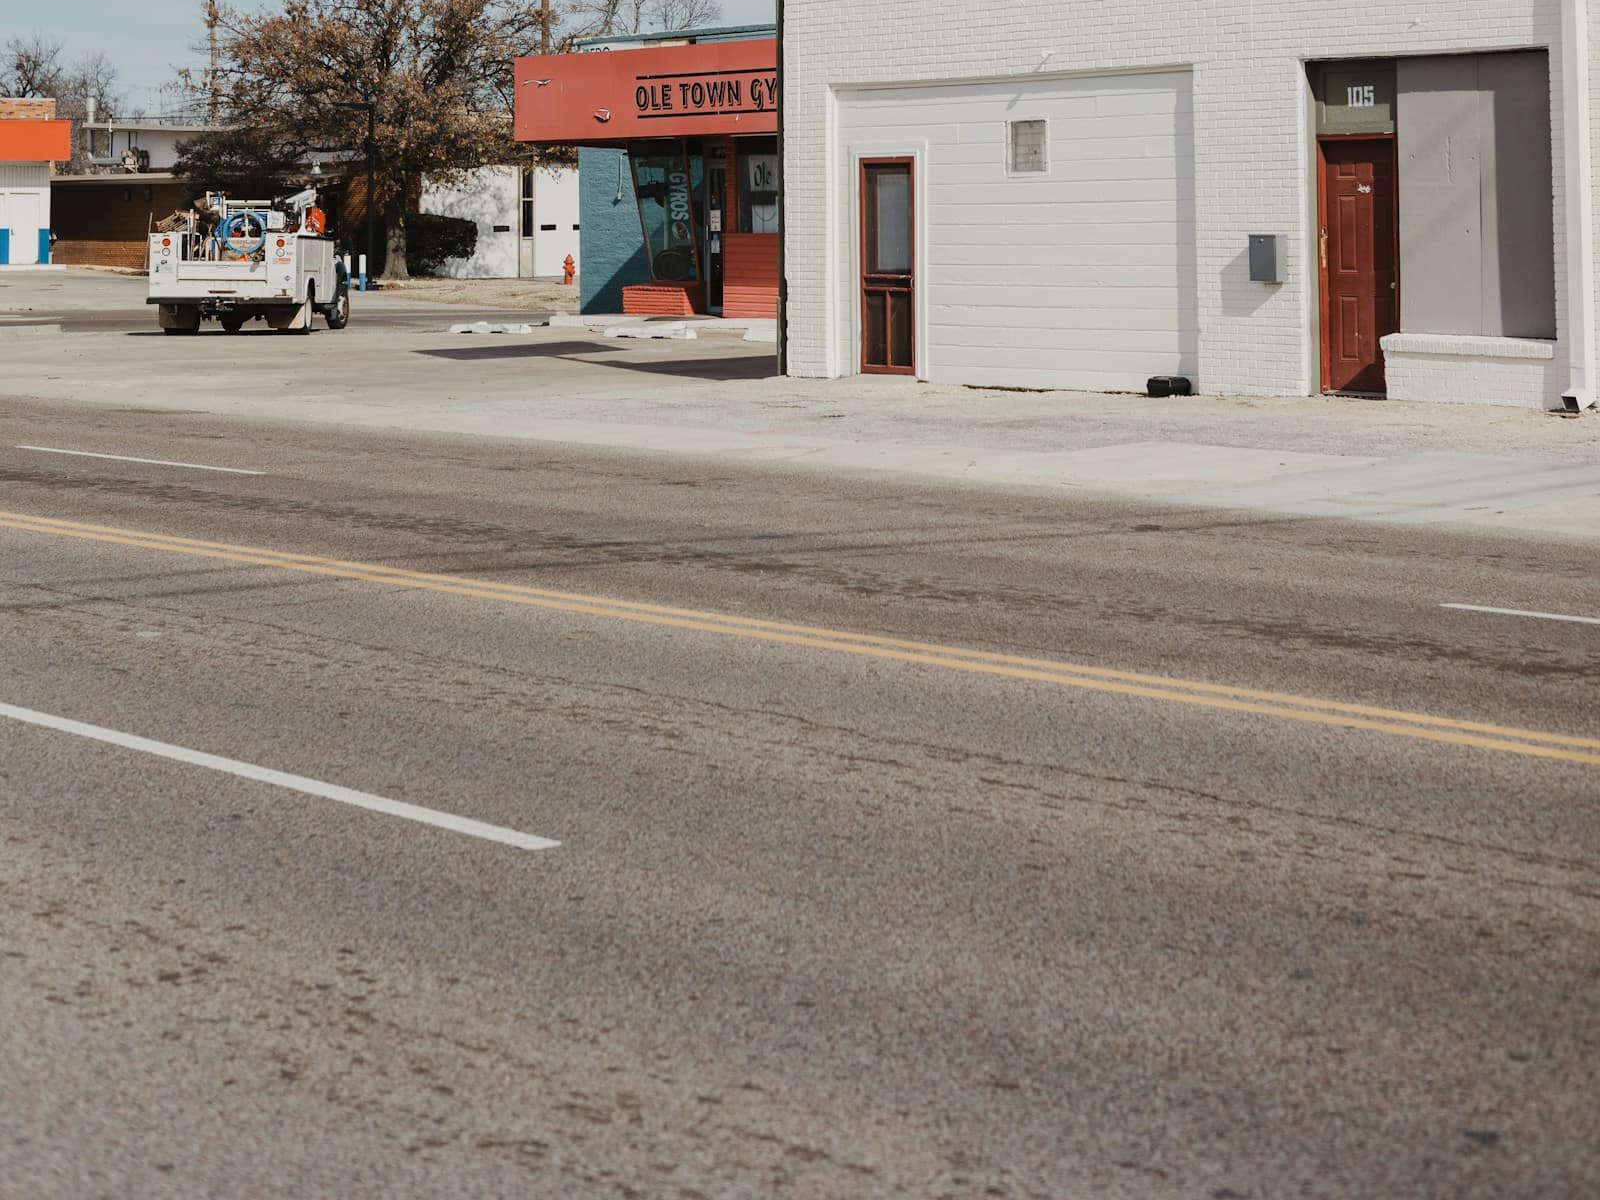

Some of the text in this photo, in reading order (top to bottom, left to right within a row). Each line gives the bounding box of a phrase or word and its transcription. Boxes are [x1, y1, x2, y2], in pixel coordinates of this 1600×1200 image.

[635, 85, 672, 110] OLE
[679, 80, 742, 109] TOWN
[1347, 86, 1375, 107] 105
[754, 161, 772, 186] Ole
[668, 172, 690, 220] GYROS
